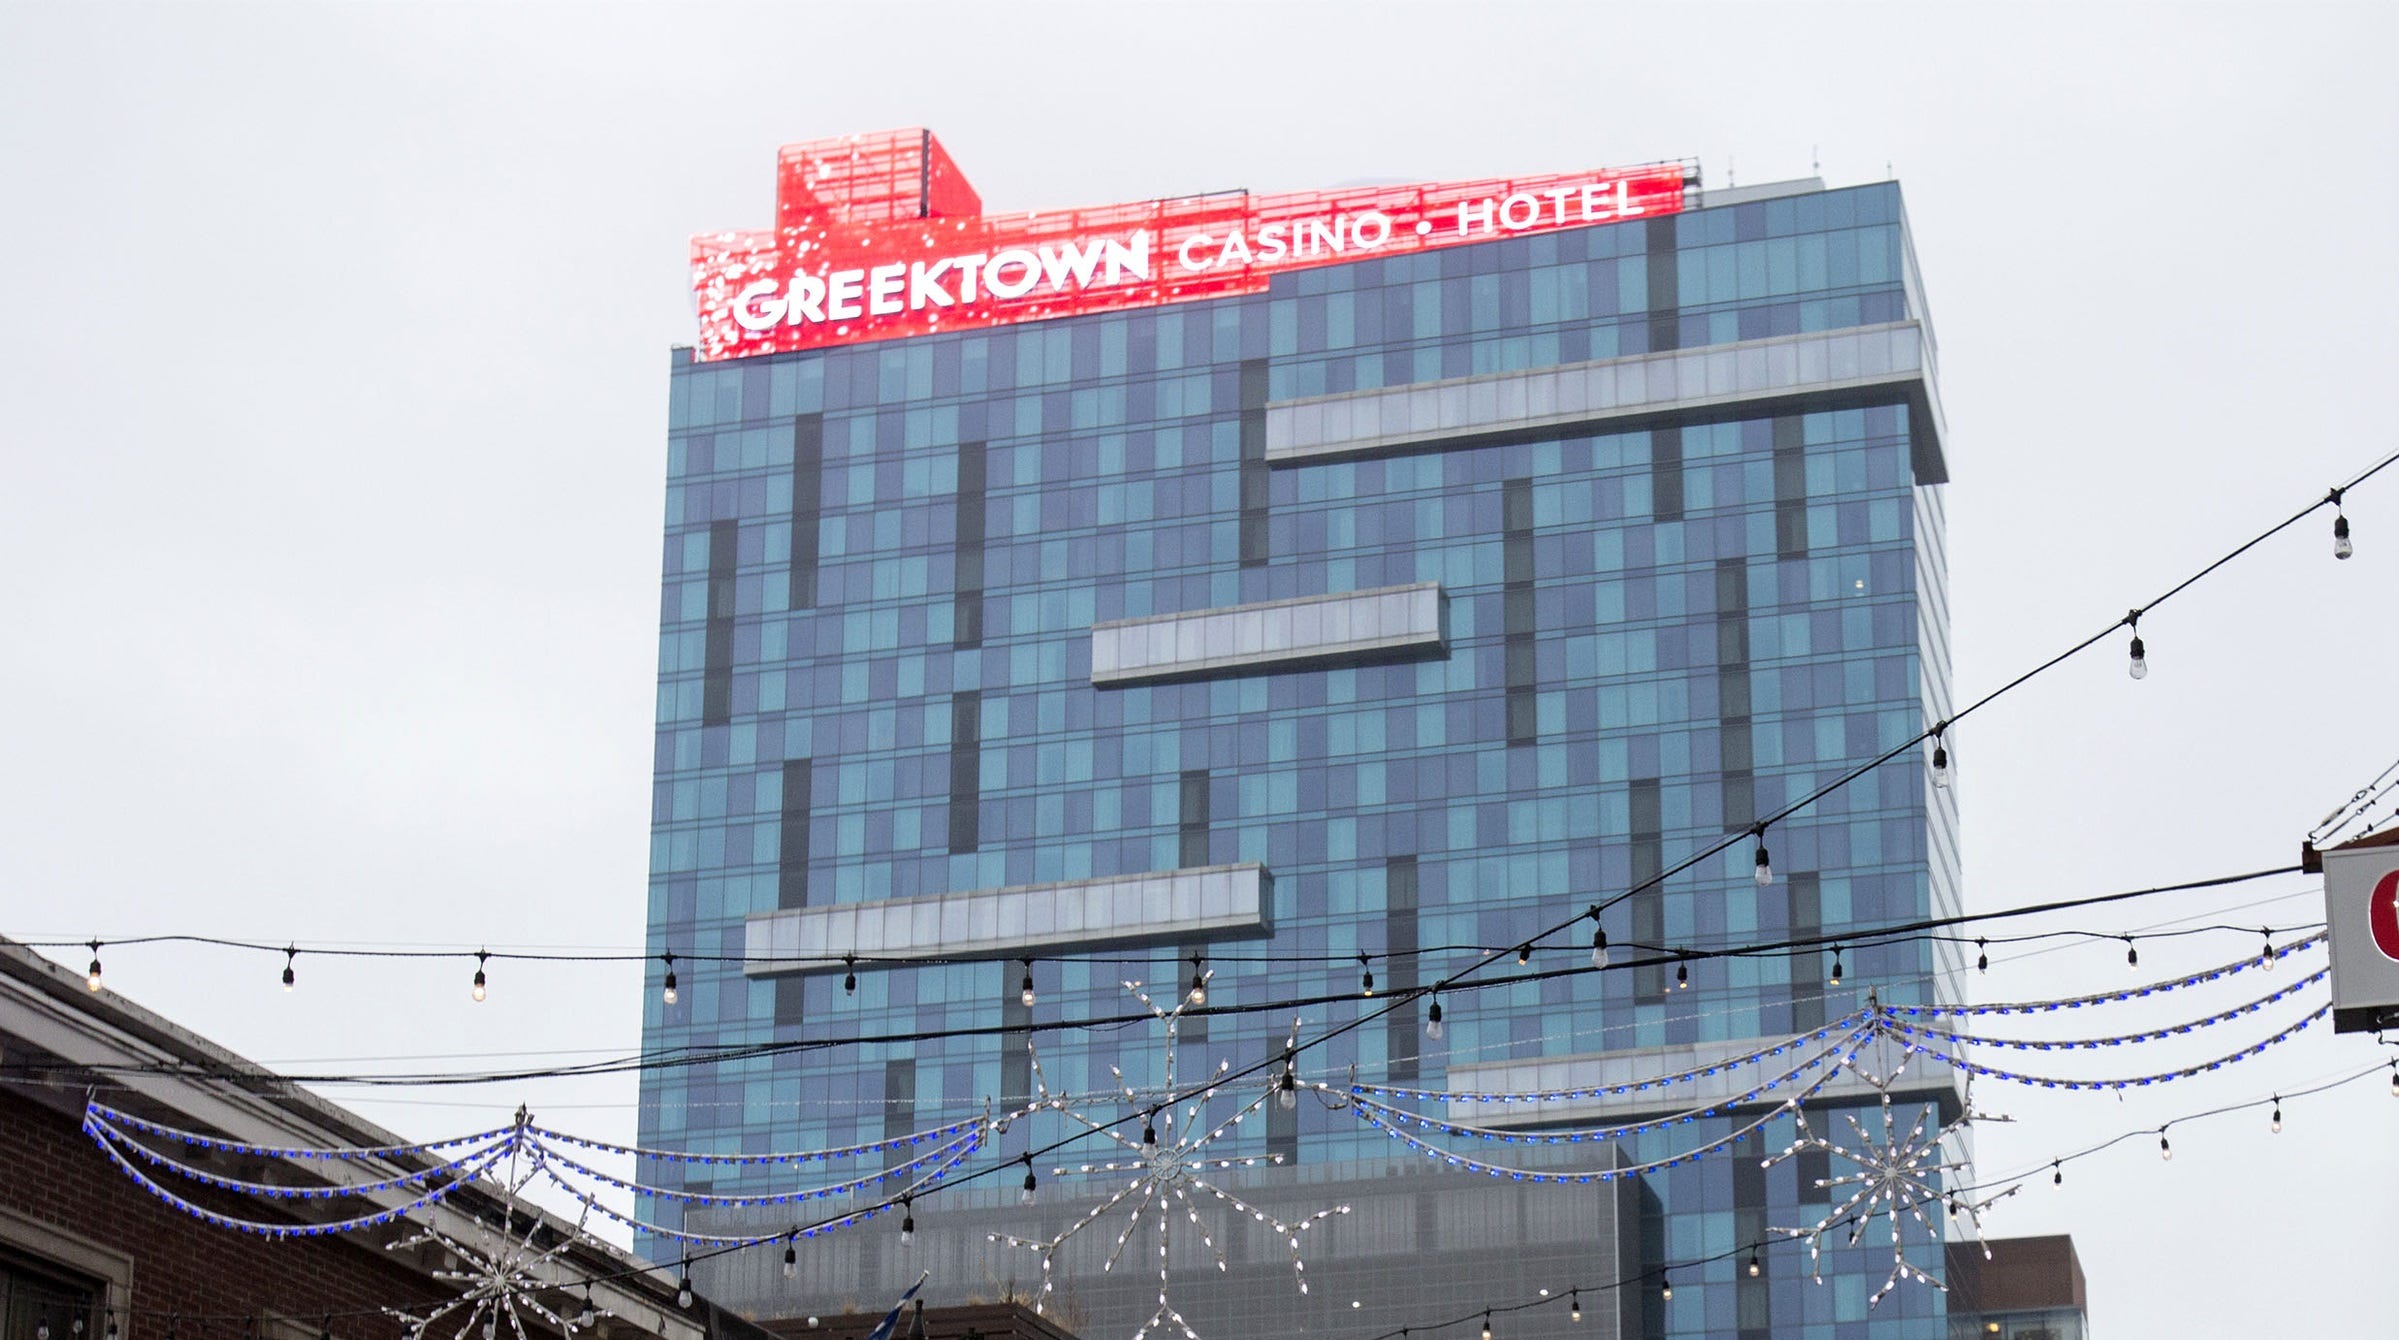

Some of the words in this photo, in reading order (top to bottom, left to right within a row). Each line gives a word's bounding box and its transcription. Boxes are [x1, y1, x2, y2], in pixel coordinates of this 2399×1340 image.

[732, 229, 1149, 332] GREEKTOWN
[1178, 212, 1391, 271] CASINO
[1458, 180, 1644, 236] HOTEL
